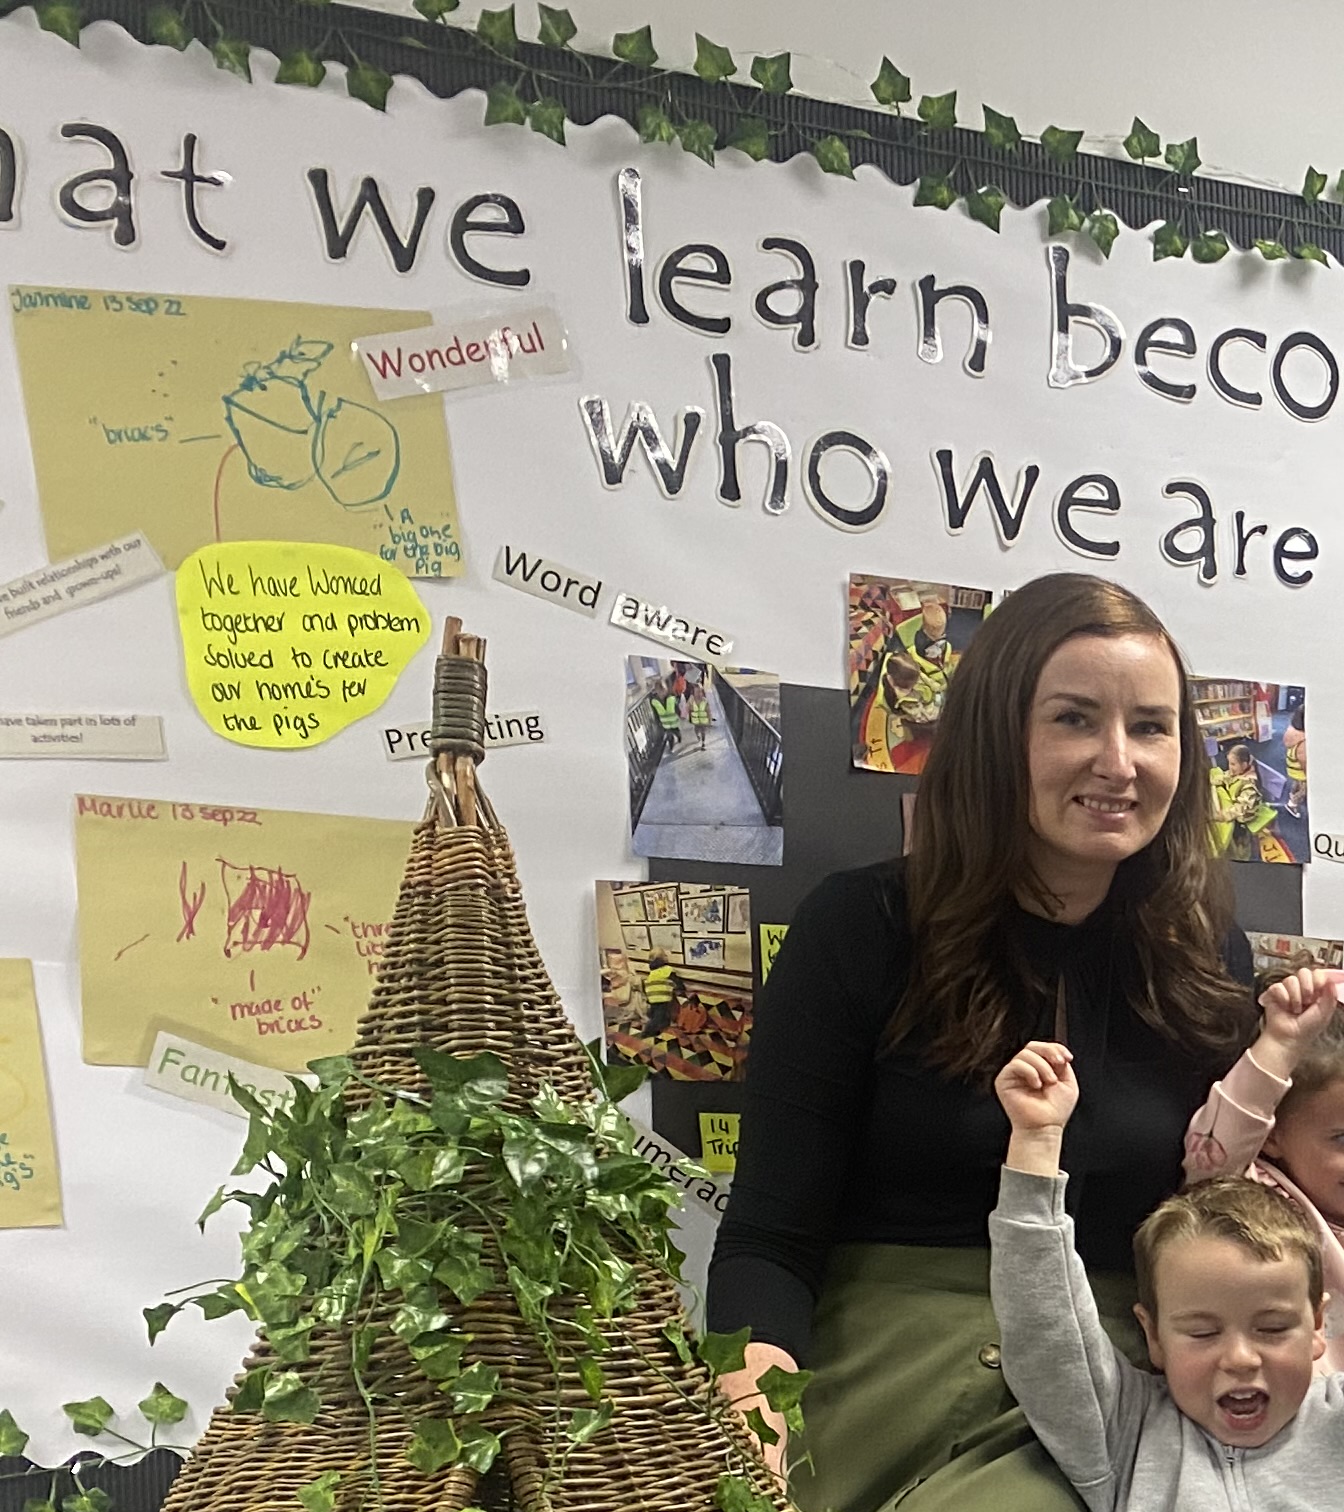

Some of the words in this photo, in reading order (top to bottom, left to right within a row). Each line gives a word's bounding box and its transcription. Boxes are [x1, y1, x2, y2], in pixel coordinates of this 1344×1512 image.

[309, 167, 531, 286] we
[619, 167, 992, 376] learn
[103, 295, 123, 312] 13
[164, 299, 186, 316] 22
[581, 352, 891, 531] who
[935, 450, 1120, 558] we
[1161, 480, 1319, 584] are
[98, 544, 122, 561] with
[199, 559, 240, 598] We
[248, 564, 300, 598] have
[42, 588, 62, 605] and
[505, 545, 602, 610] Word
[622, 597, 727, 656] aware
[201, 607, 285, 645] together
[302, 612, 337, 632] and
[348, 610, 420, 636] problem
[291, 647, 313, 668] to
[212, 681, 241, 703] our
[25, 715, 58, 726] taken
[60, 716, 83, 728] part
[85, 716, 98, 726] in
[99, 715, 121, 726] lots
[123, 715, 137, 726] of
[223, 714, 262, 731] the
[273, 706, 320, 738] pigs
[385, 714, 544, 753] Preting
[171, 804, 194, 821] 13
[710, 1119, 729, 1134] 14
